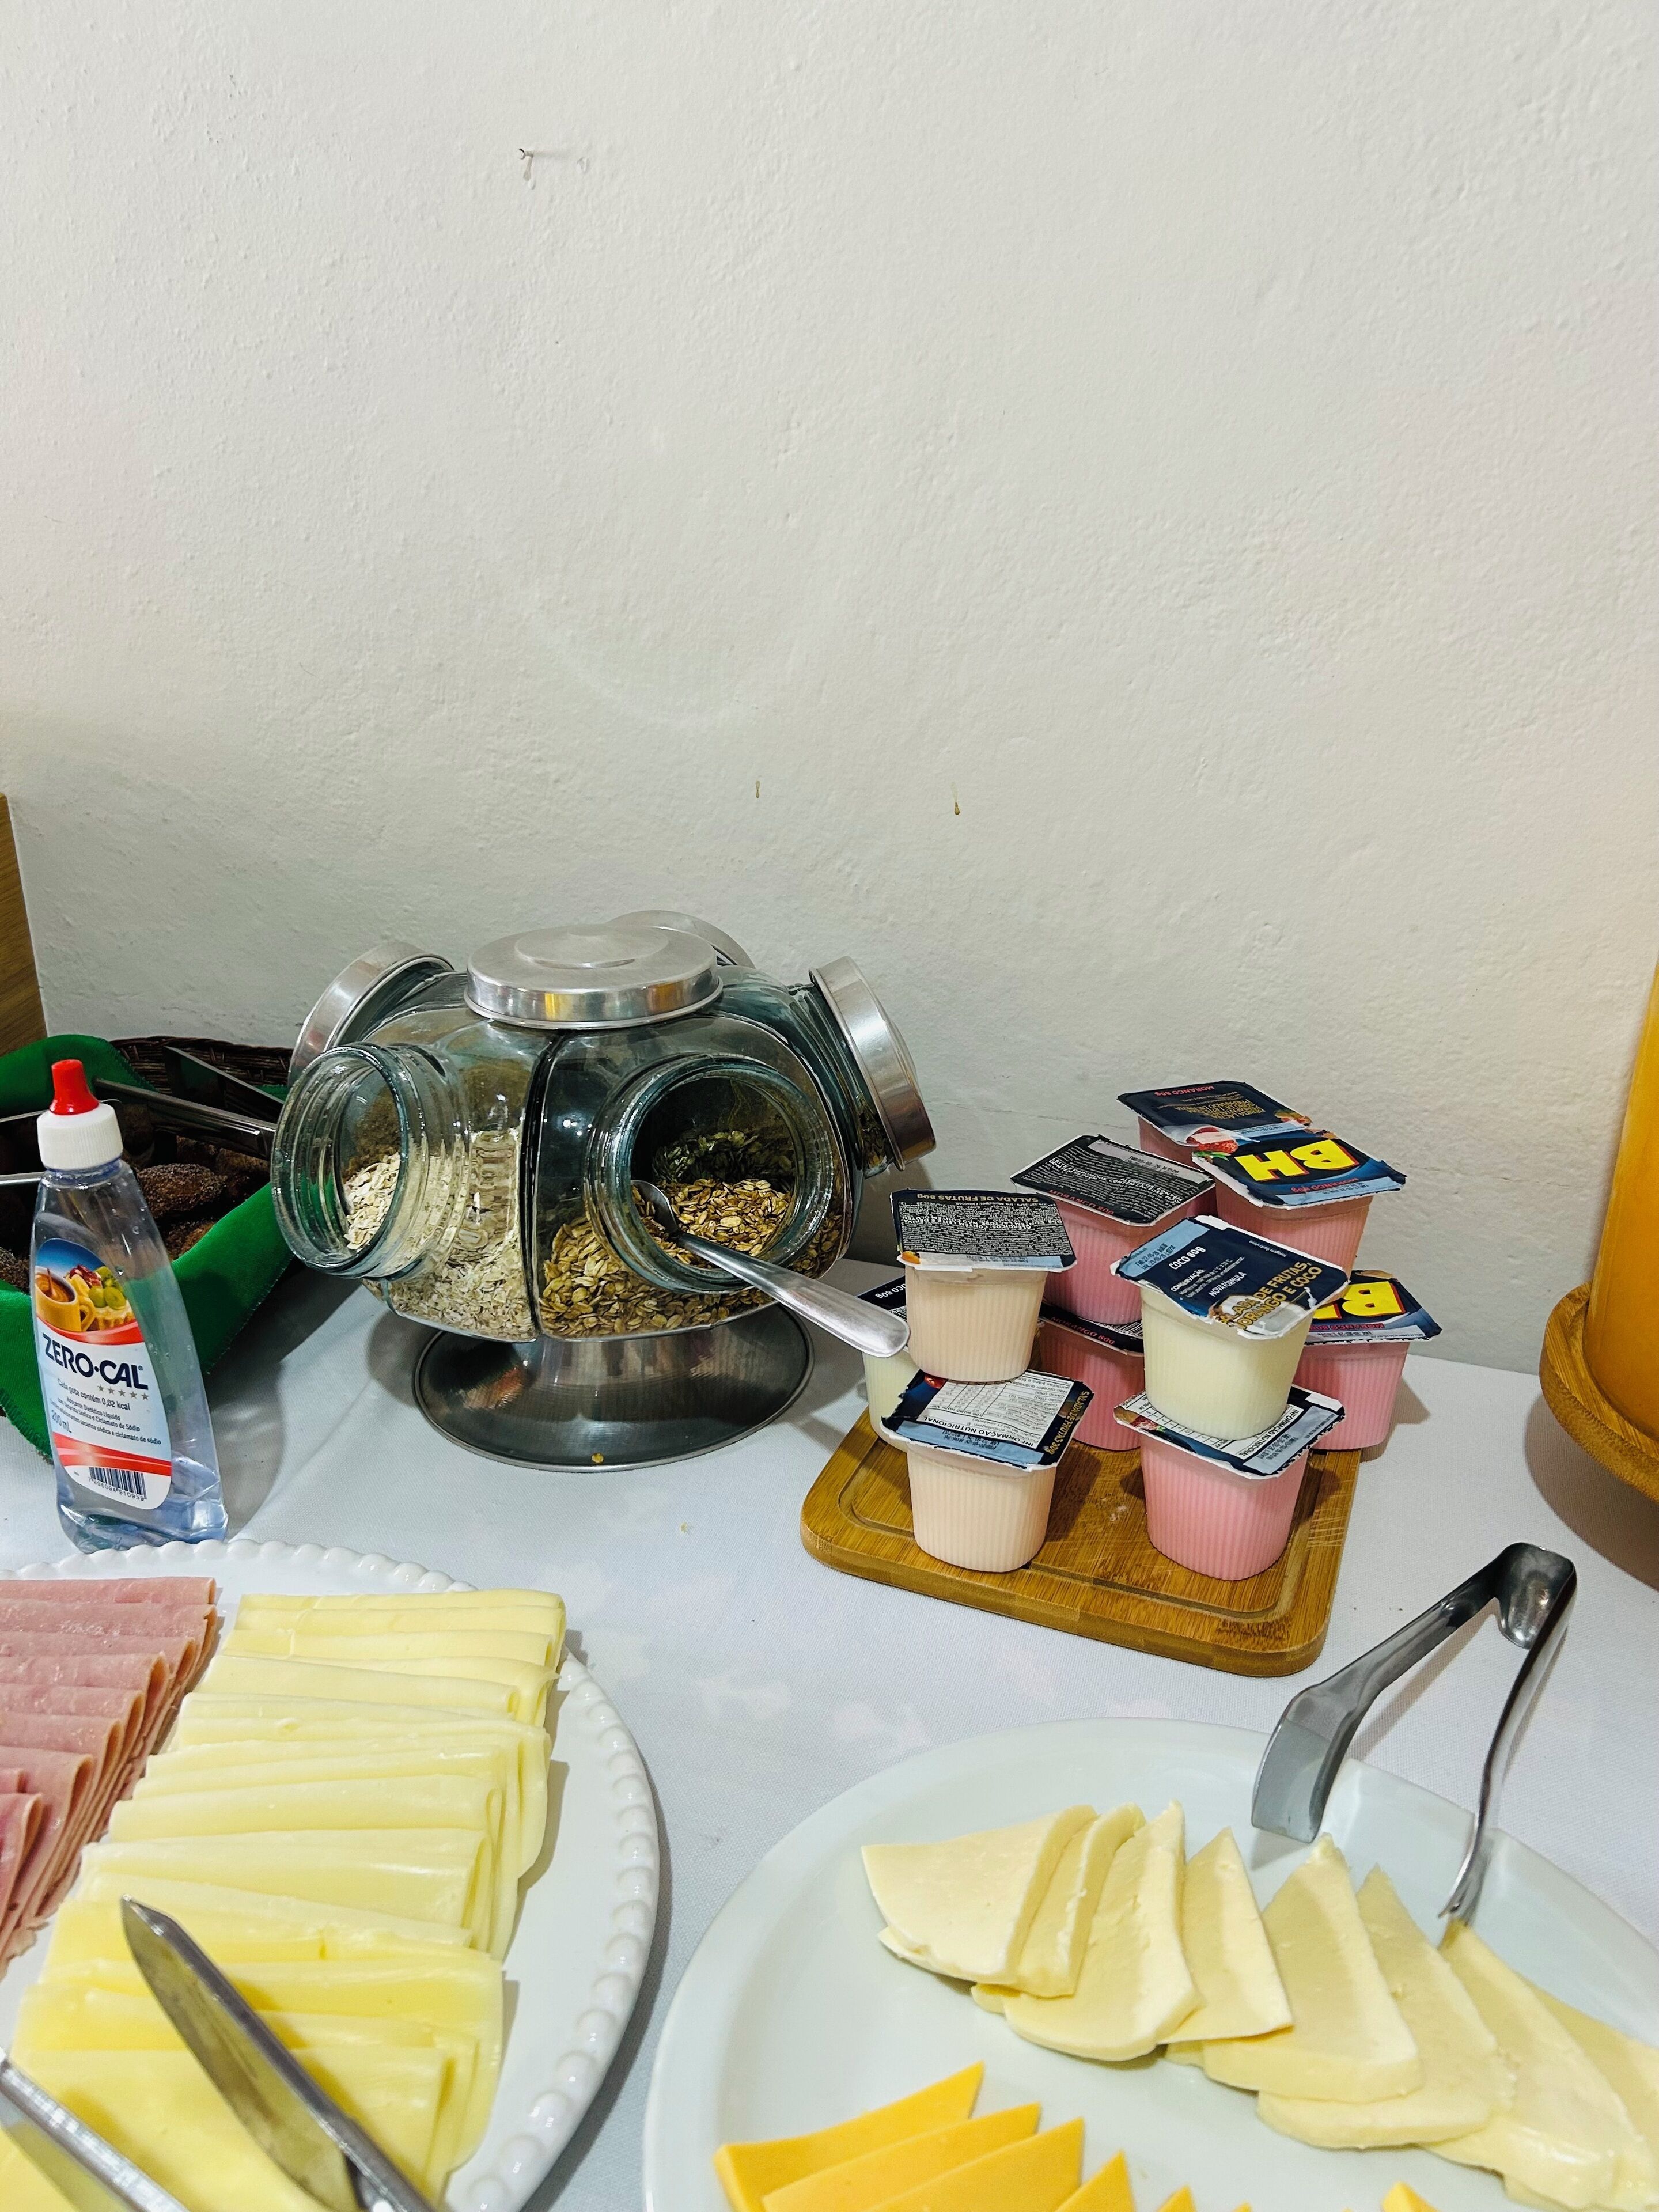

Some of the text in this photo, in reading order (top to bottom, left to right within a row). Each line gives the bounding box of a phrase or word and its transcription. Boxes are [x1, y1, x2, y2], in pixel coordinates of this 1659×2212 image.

[1172, 1086, 1215, 1095] MORANGO
[1234, 1139, 1360, 1181] BH
[1168, 1255, 1191, 1270] COCO
[1187, 1245, 1206, 1258] 80g
[1253, 1286, 1274, 1300] DE
[1267, 1261, 1312, 1288] FRUTAS,
[1282, 1286, 1296, 1295] E
[1290, 1266, 1323, 1287] COCO
[875, 1290, 893, 1298] 80g
[81, 1392, 101, 1404] contém
[102, 1397, 115, 1407] 0,02
[116, 1400, 131, 1411] kcal
[924, 1416, 978, 1434] NUTRICIONAL
